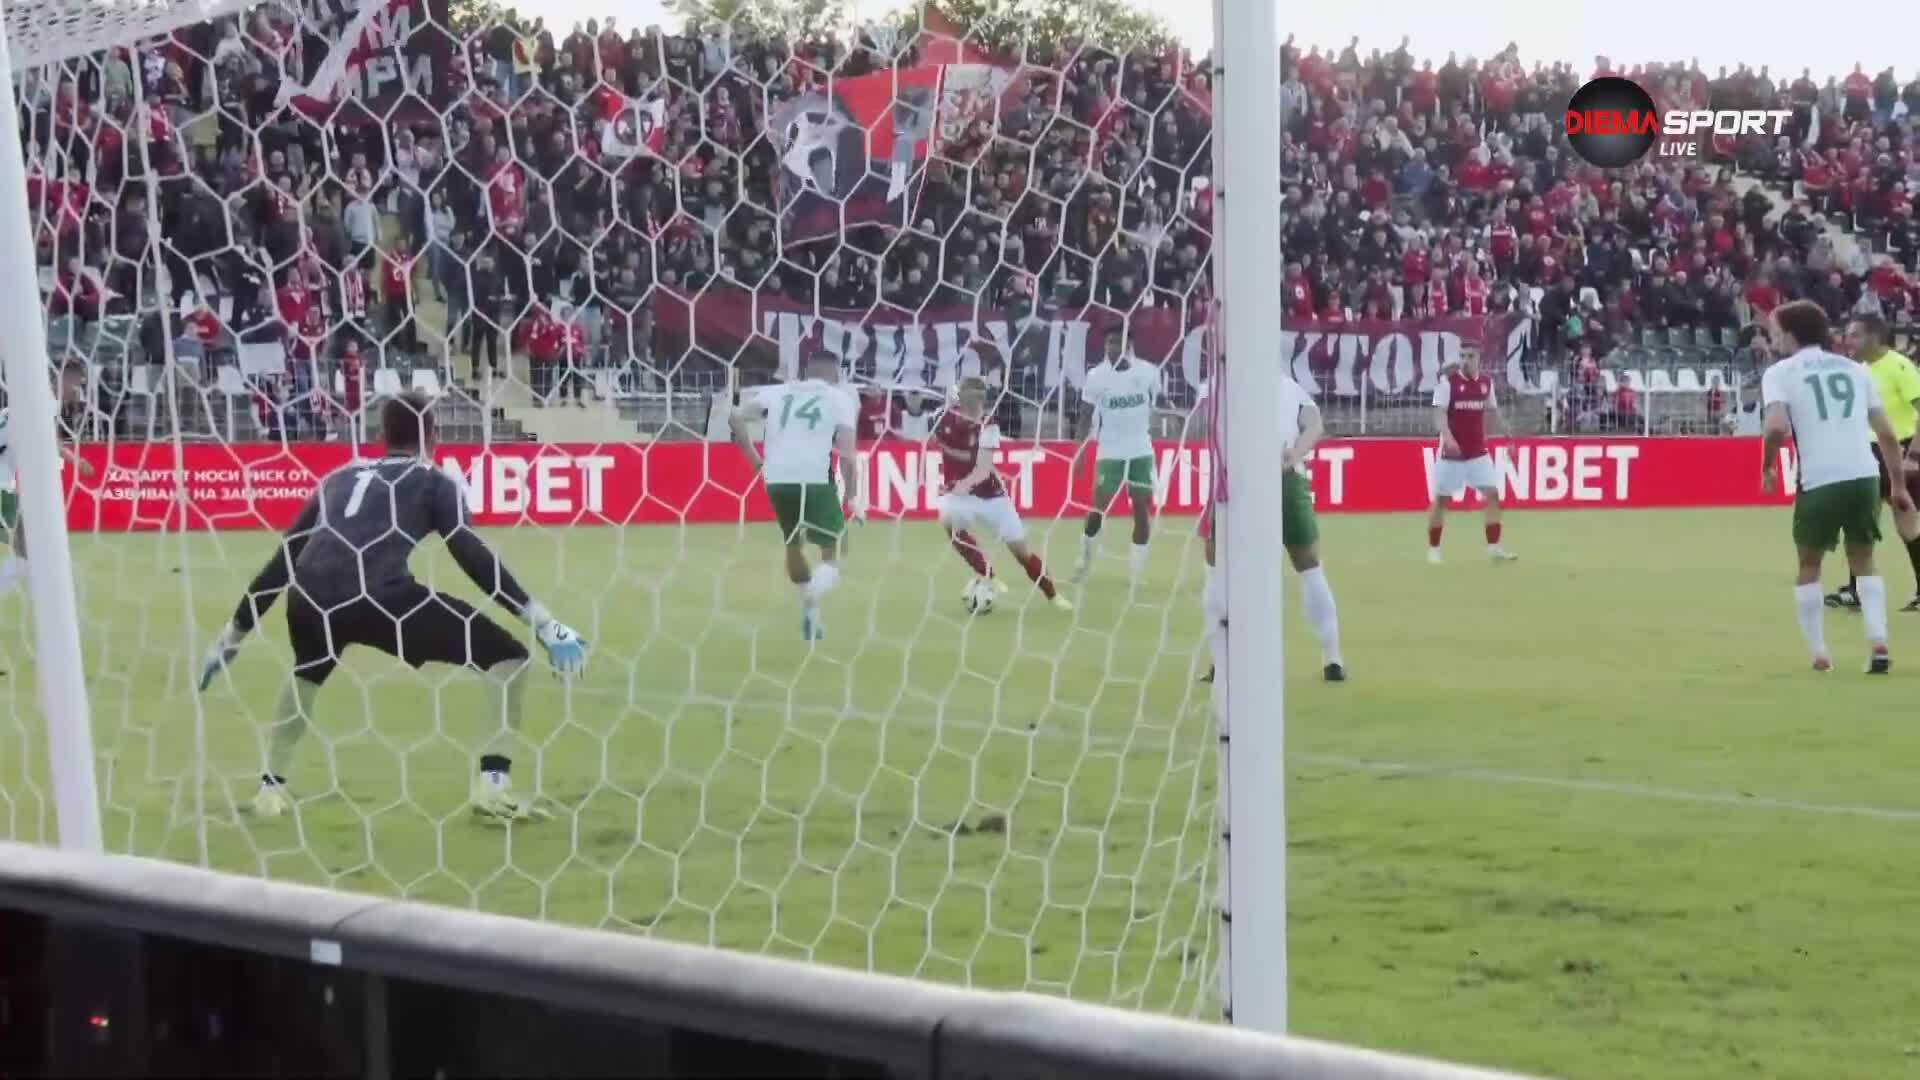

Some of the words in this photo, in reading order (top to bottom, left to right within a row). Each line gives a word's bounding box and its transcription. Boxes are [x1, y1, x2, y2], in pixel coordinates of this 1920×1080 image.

[779, 394, 822, 430] 14
[1804, 372, 1856, 421] 19
[193, 470, 239, 482] НОСИ
[193, 488, 216, 500] НА
[443, 456, 615, 513] NBET
[1423, 446, 1639, 501] WNBET
